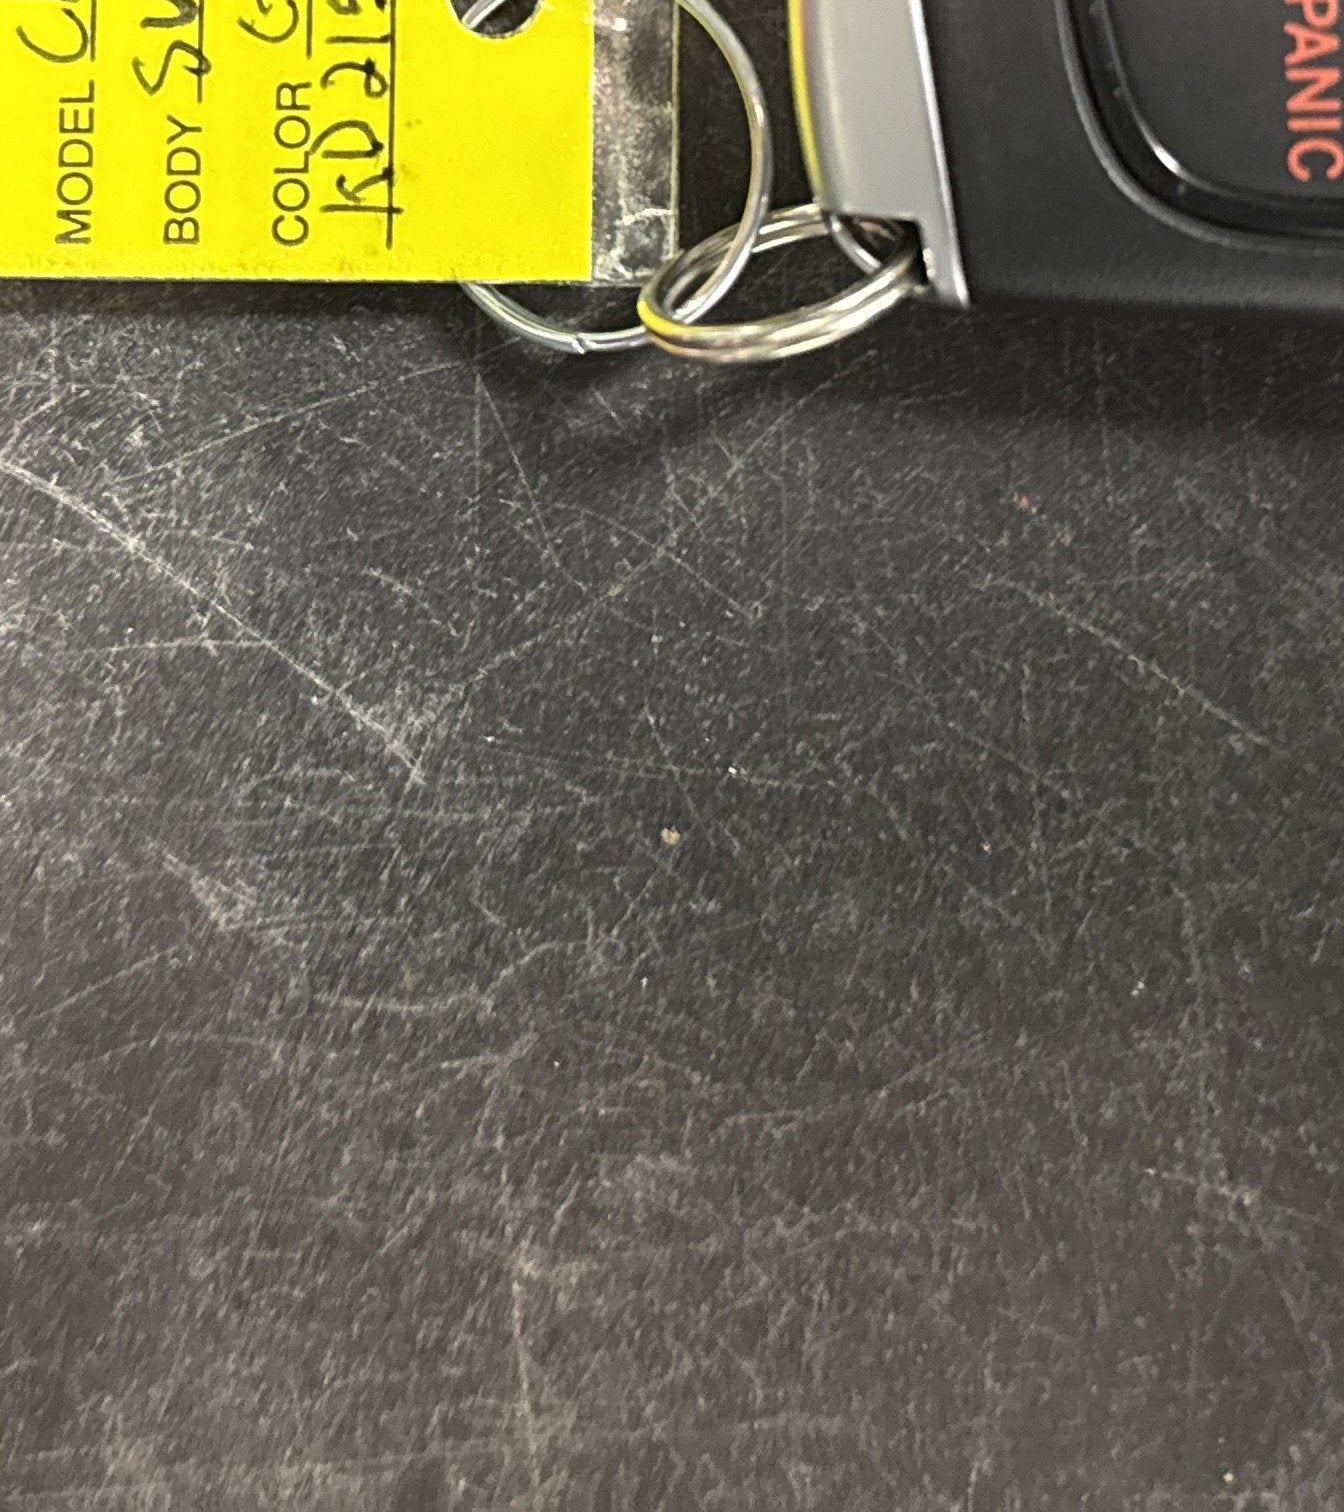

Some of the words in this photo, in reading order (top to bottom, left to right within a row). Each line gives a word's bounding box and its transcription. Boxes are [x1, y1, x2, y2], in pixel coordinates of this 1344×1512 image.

[56, 80, 95, 244] MODEL
[163, 115, 202, 244] BODY
[271, 82, 312, 246] COLOR
